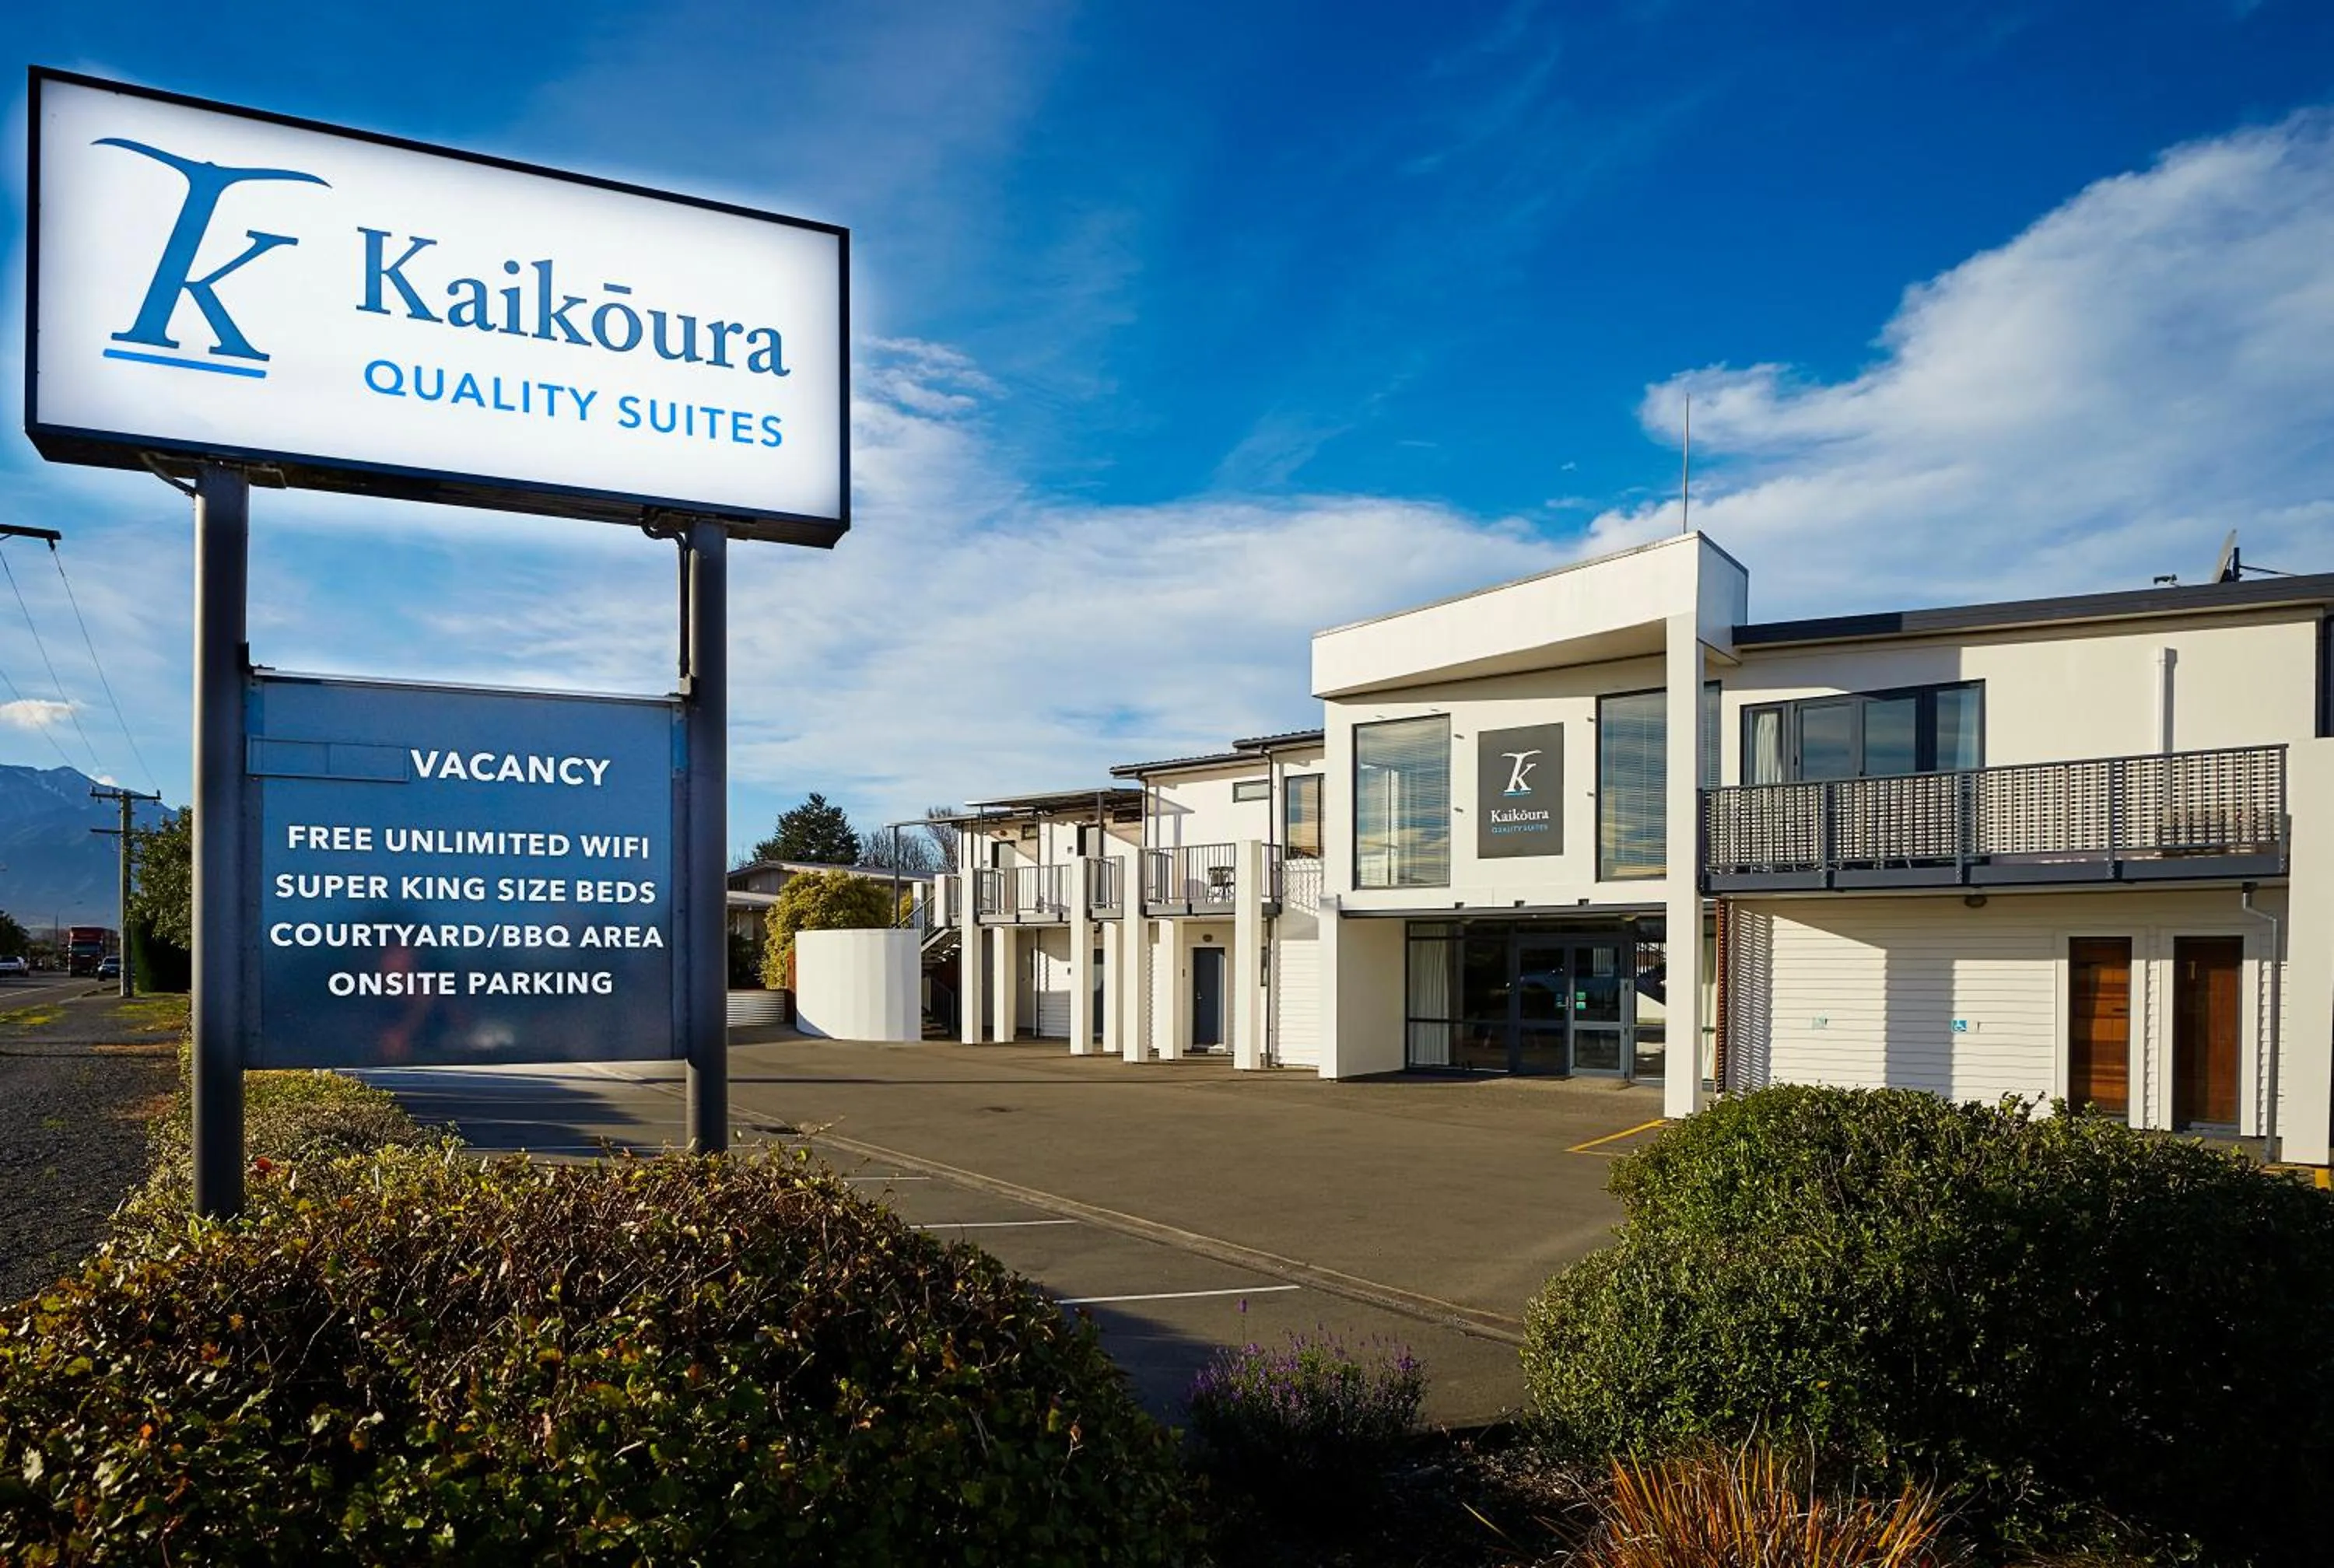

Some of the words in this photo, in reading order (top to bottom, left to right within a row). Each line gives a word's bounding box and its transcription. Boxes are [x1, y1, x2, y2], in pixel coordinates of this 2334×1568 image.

[356, 226, 791, 377] Kaikōura
[363, 359, 598, 421] QUALITY
[618, 395, 783, 448] SUITES
[410, 749, 611, 786] VACANCY
[289, 825, 373, 851] FREE
[385, 828, 570, 856] UNLIMITED
[580, 835, 649, 859] WIFI
[275, 873, 388, 898] SUPER
[401, 877, 485, 901] KING
[497, 878, 566, 901] SIZE
[576, 880, 656, 905] BEDS
[270, 922, 571, 948] COURTYARD/BBQ
[580, 926, 664, 948] AREA
[328, 971, 456, 996] ONSITE
[468, 971, 612, 995] PARKING
